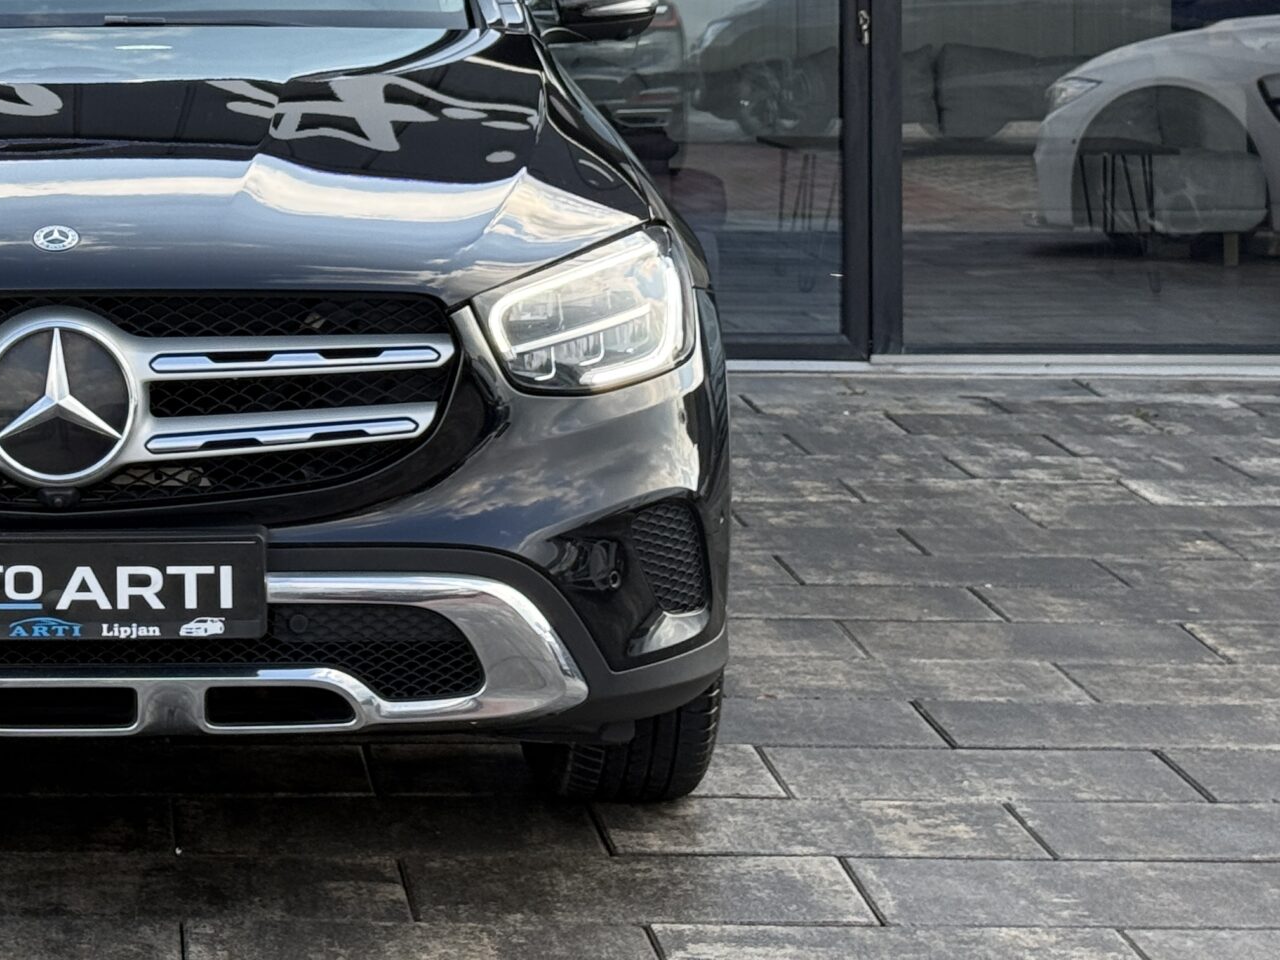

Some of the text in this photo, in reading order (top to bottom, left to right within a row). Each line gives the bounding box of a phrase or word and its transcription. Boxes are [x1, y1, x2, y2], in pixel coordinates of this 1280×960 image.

[55, 565, 233, 610] ARTI
[9, 625, 81, 637] ARTI
[101, 623, 161, 638] Lipjan
